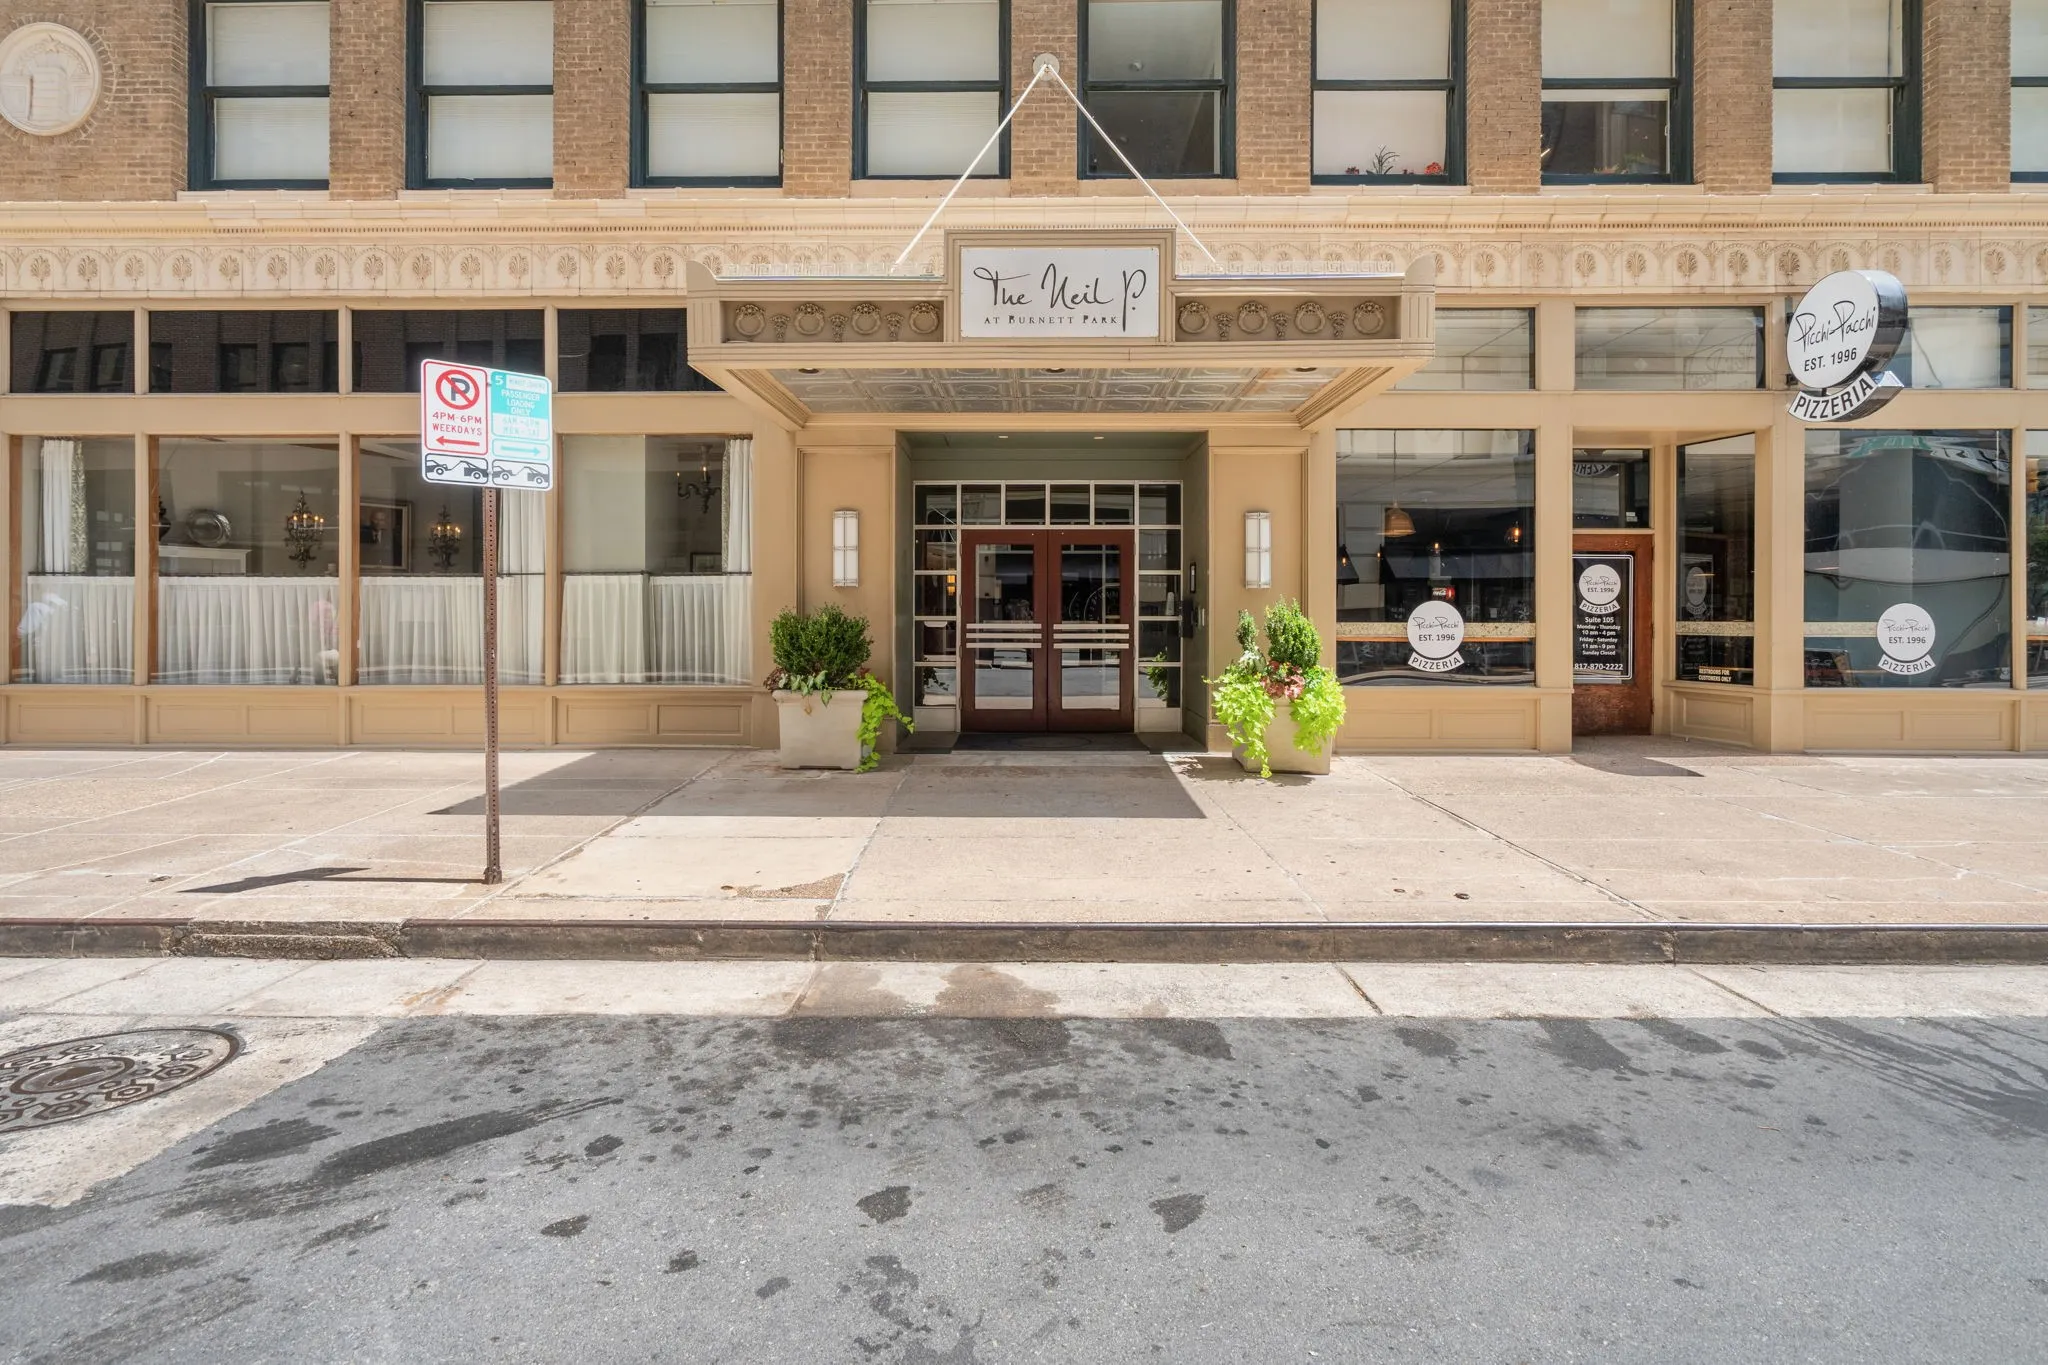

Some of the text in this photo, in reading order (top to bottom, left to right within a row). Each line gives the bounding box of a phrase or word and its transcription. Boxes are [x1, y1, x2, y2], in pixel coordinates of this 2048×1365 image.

[973, 266, 1032, 305] The
[1041, 263, 1114, 309] Neil
[984, 315, 1117, 324] AT BURNETT PARK
[1804, 347, 1857, 372] EST. 1996
[495, 375, 504, 385] 5
[501, 389, 540, 400] PASSENGER
[1793, 377, 1874, 419] PIZZERIA
[507, 398, 535, 408] LOADING
[511, 406, 531, 415] ONLY
[432, 423, 482, 436] WEEKDAYS
[1581, 603, 1618, 613] PIZZERIA
[1888, 636, 1926, 644] EST. 1996
[1411, 656, 1461, 670] PIZZERIA
[1881, 659, 1932, 673] PIZZERIA
